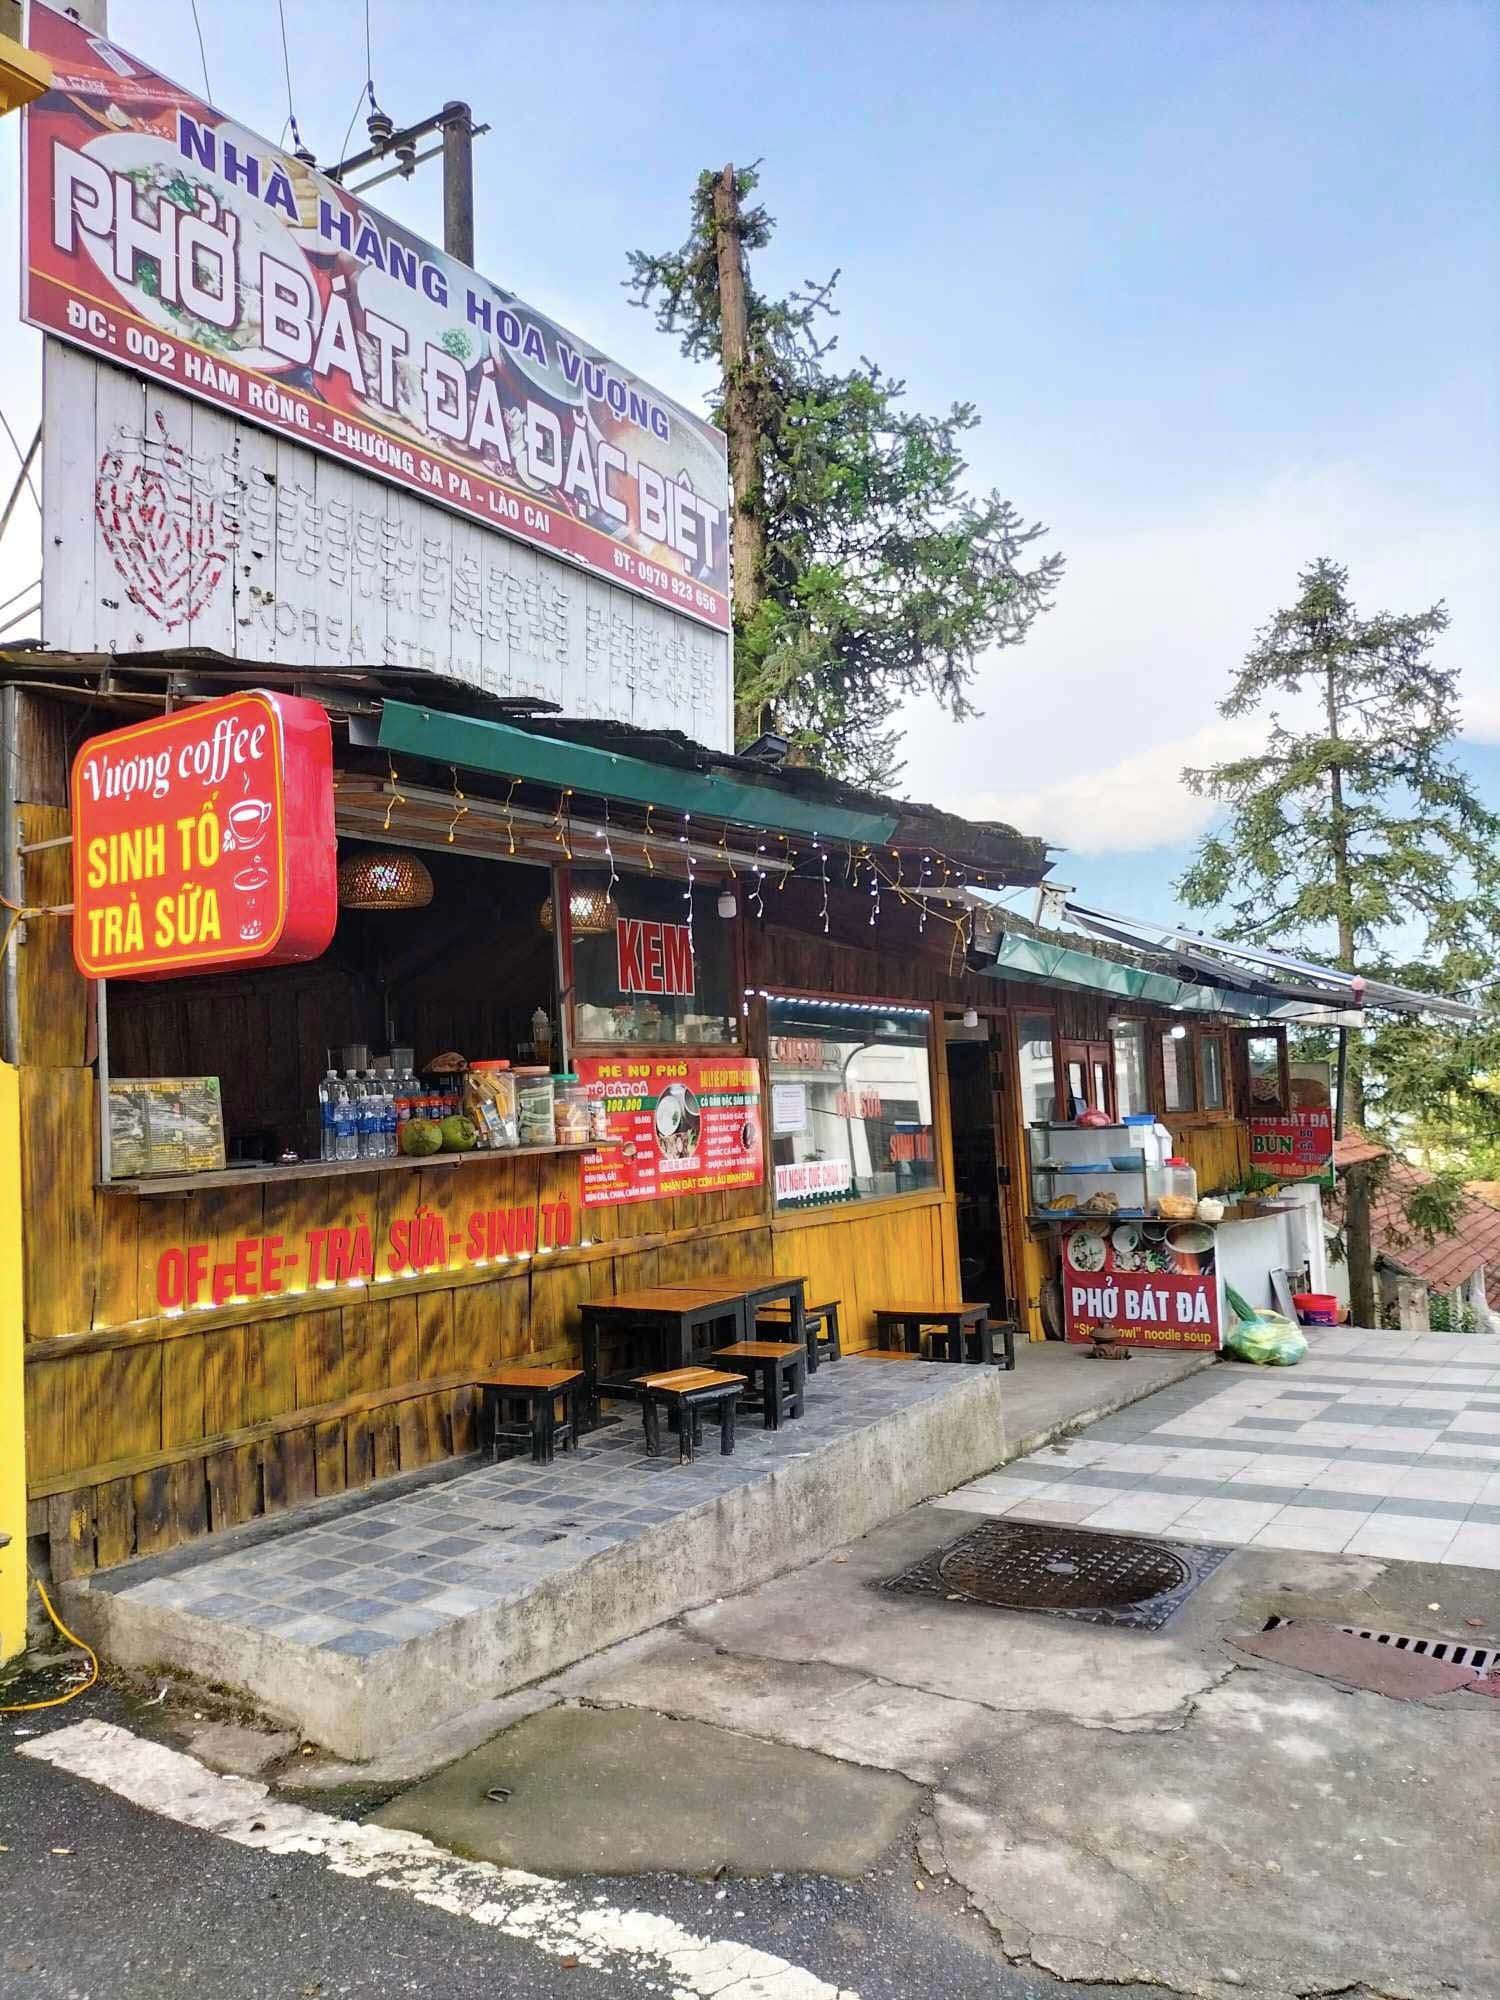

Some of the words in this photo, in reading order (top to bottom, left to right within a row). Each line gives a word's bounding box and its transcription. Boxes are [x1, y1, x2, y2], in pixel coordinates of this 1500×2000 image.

[178, 108, 300, 222] NHÀ
[319, 200, 449, 308] HÀNG
[466, 288, 548, 367] HOA
[558, 342, 671, 442] VƯỢNG
[52, 139, 241, 327] PHỞ
[261, 252, 407, 409] BÁT
[422, 342, 511, 465] ĐÁ
[523, 400, 630, 523] ĐẶC
[637, 461, 720, 573] BIỆT
[66, 299, 117, 345] ĐC:
[126, 326, 177, 370] 002
[184, 354, 241, 398] HÀM
[248, 381, 311, 429] RỒNG
[333, 420, 416, 477] PHƯỜNG
[420, 463, 443, 490] SA
[448, 472, 471, 502] PA
[489, 492, 520, 524] LÀO
[524, 507, 550, 534] CAI
[613, 549, 634, 576] ĐT:
[638, 560, 669, 591] 0979
[672, 573, 694, 603] 923
[696, 585, 717, 614] 656
[83, 749, 172, 801] Vượng
[178, 717, 265, 786] coffee
[87, 824, 165, 888] SINH
[177, 791, 220, 871] TỐ
[88, 892, 144, 957] TRÀ
[155, 882, 221, 948] SỮA
[617, 917, 695, 996] KEM
[587, 1082, 605, 1097] HỞ
[598, 1065, 622, 1078] ME
[628, 1065, 651, 1077] NU
[656, 1061, 688, 1077] PHỞ
[607, 1098, 641, 1112] 100.000
[1253, 1130, 1293, 1155] BÚN
[307, 1213, 374, 1284] TRÀ
[467, 1206, 534, 1262] SINH
[541, 1192, 572, 1247] TỐ
[1072, 1276, 1119, 1319] PHỞ
[1125, 1283, 1170, 1321] BÁT
[1176, 1286, 1211, 1324] ĐÁ
[1144, 1327, 1181, 1341] noodle
[1184, 1332, 1211, 1345] soup
